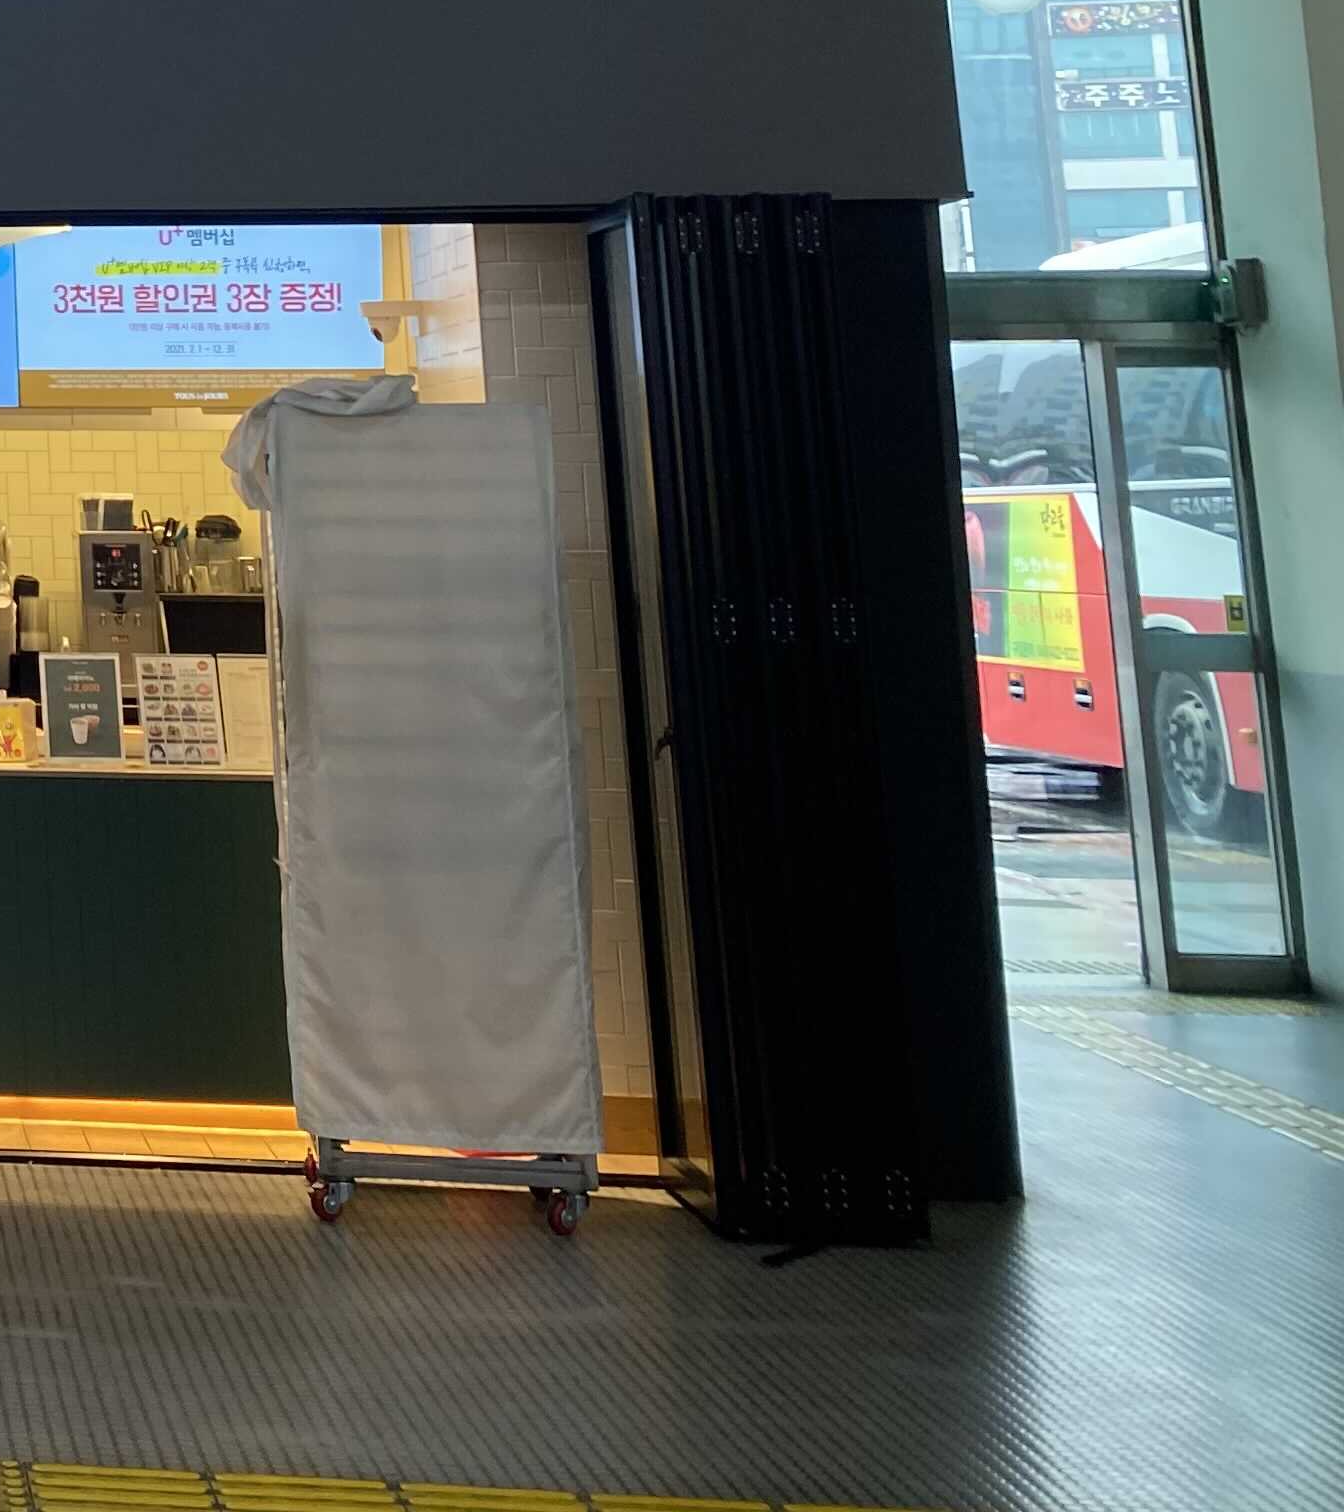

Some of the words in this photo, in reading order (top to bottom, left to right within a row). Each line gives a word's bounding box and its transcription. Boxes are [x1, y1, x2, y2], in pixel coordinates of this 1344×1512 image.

[186, 228, 234, 247] 멤버십
[53, 284, 123, 314] 3천원
[134, 283, 217, 314] 할인권
[226, 283, 271, 314] 3장
[279, 283, 343, 313] 증정!
